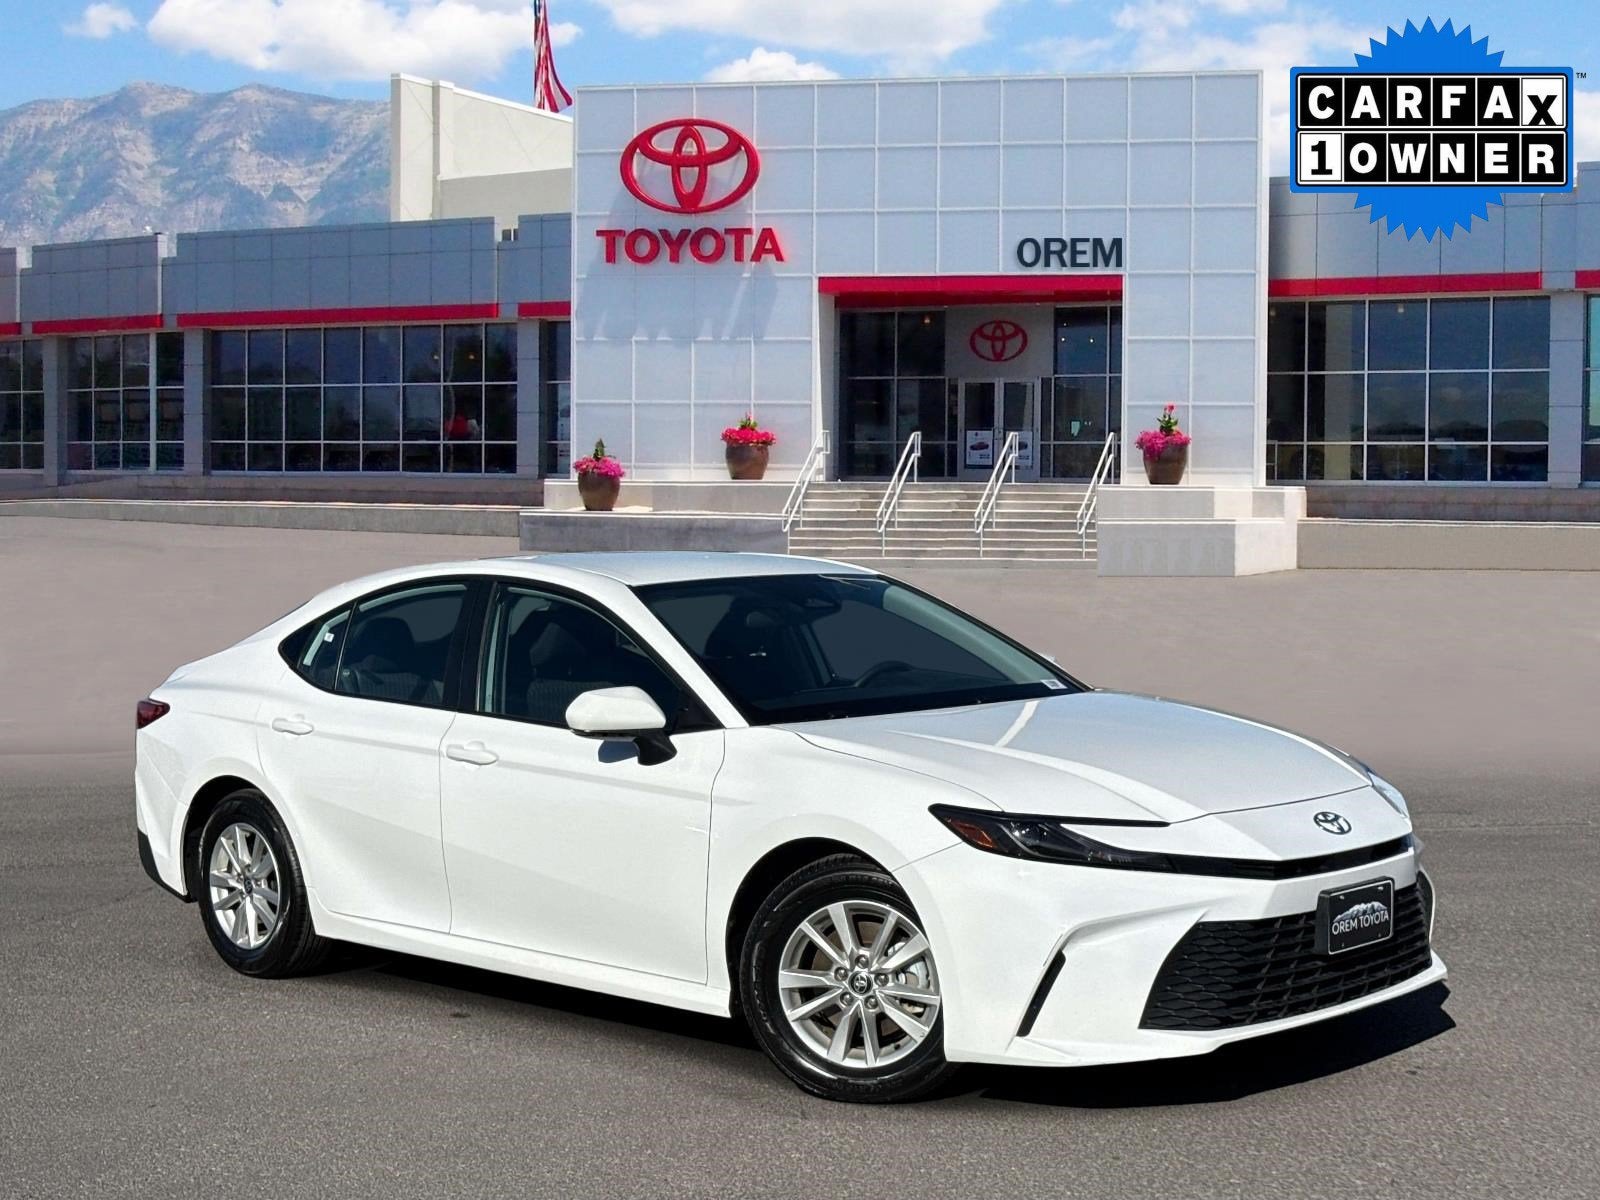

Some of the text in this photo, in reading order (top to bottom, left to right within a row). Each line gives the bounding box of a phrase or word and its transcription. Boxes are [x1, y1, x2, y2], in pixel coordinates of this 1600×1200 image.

[596, 227, 785, 264] TOYOTA
[1016, 237, 1123, 268] OREM
[1332, 910, 1389, 935] OREM TOYOTA
